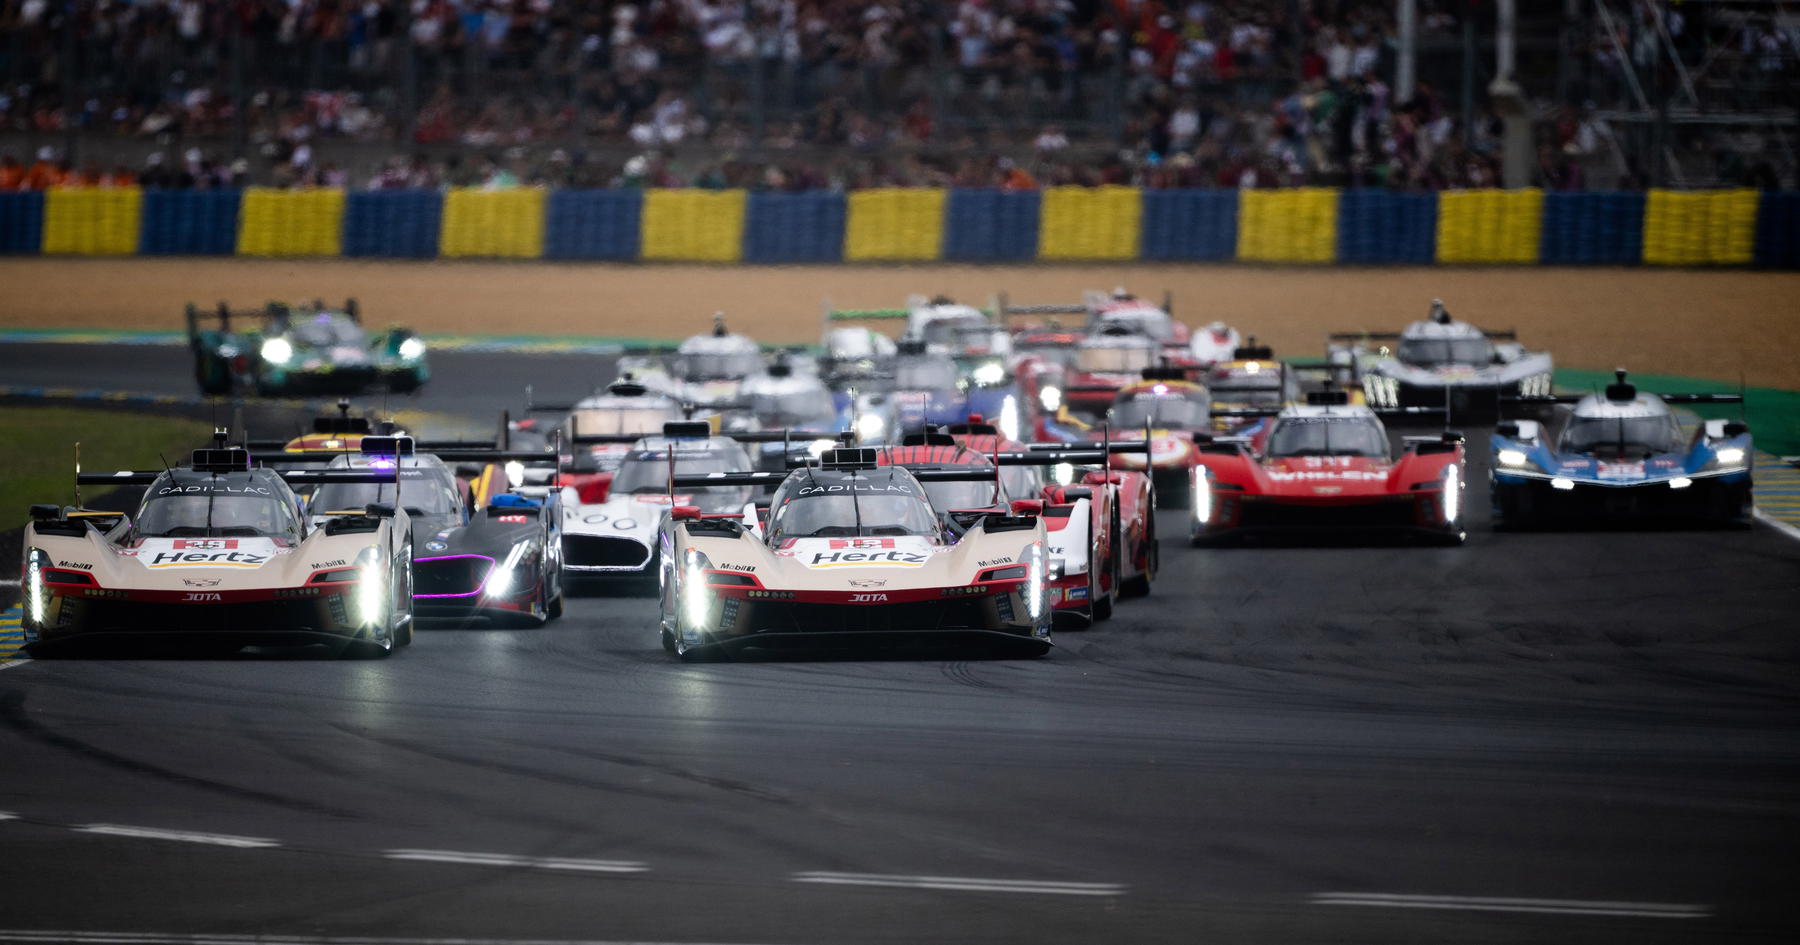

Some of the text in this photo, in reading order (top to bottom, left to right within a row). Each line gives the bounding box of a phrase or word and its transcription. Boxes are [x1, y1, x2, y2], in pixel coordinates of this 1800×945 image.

[1267, 471, 1388, 480] WHELEN
[158, 486, 271, 495] CADILLAC
[800, 484, 912, 495] CADILLAC
[151, 552, 268, 565] Hertz
[811, 551, 928, 565] Hertz
[181, 593, 222, 601] JOTA
[848, 593, 889, 602] JOTA
